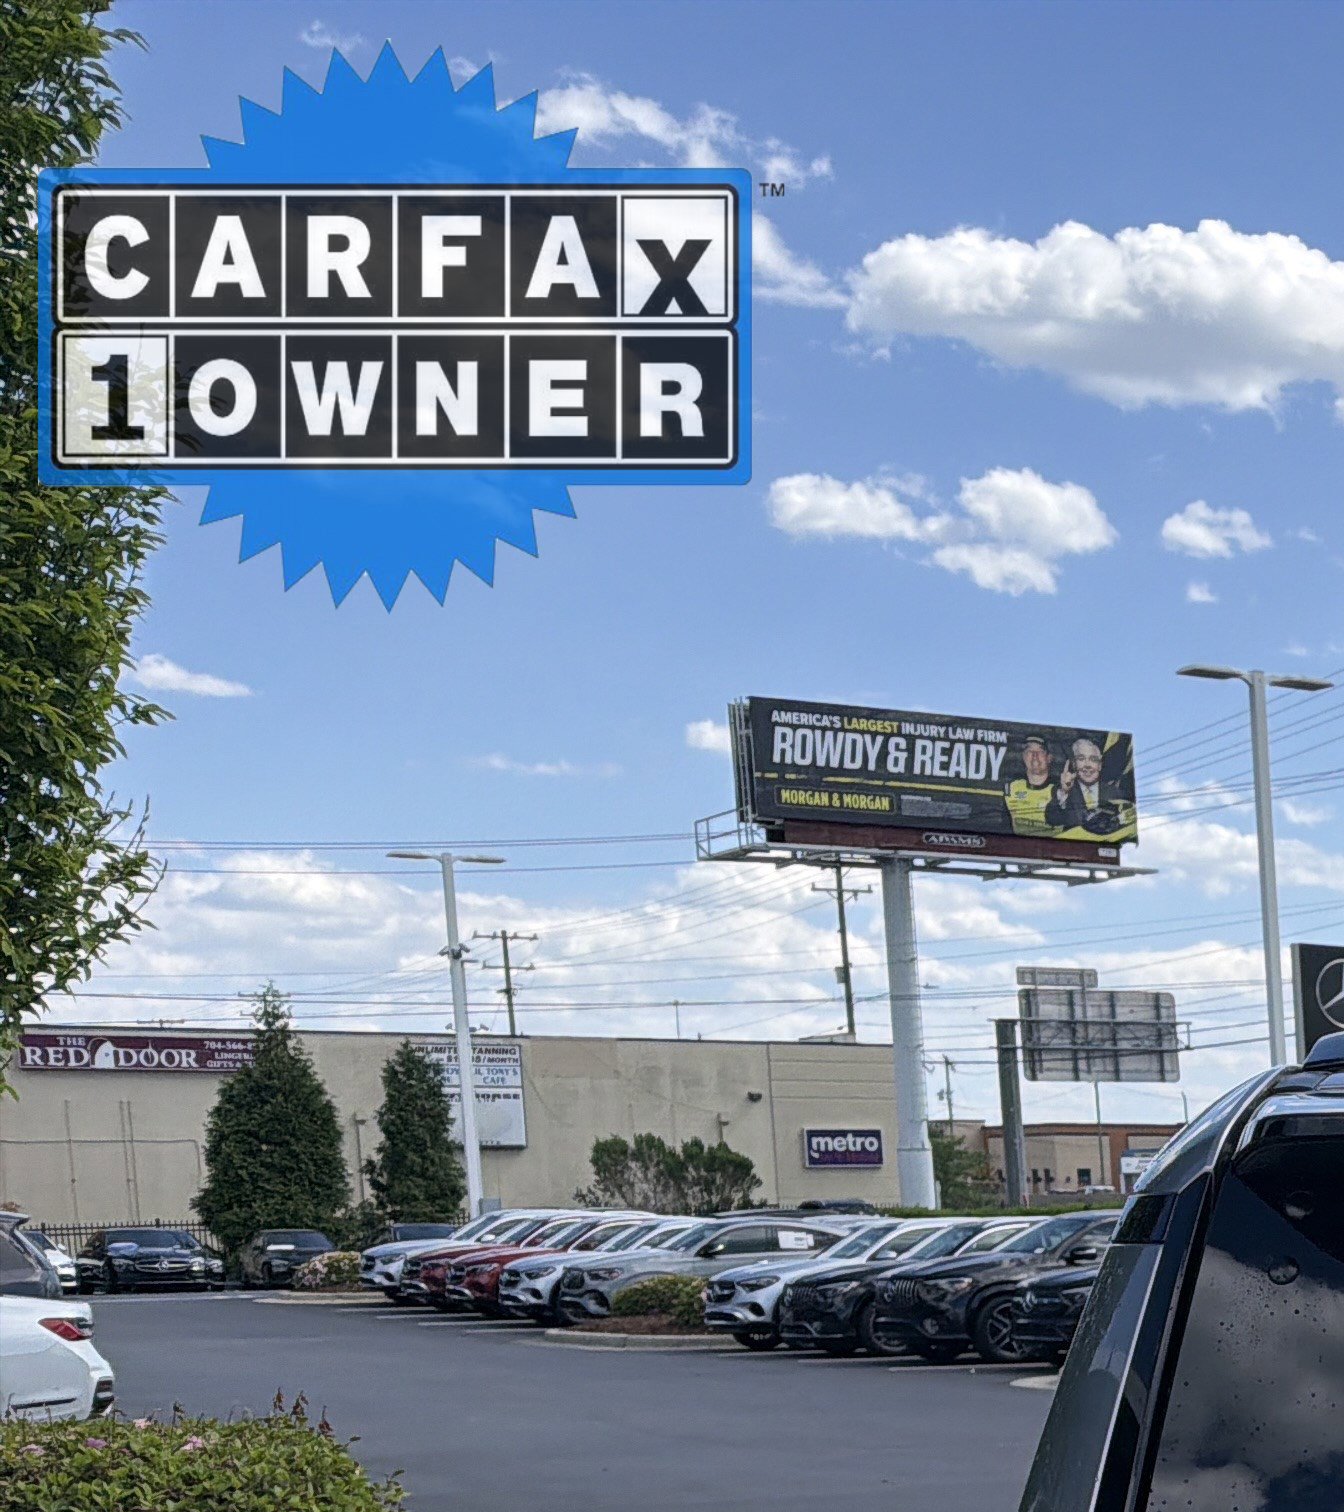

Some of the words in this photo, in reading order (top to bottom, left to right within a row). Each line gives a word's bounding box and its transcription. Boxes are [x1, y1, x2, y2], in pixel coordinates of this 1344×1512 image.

[771, 709, 842, 729] AMERICA'S
[843, 716, 899, 734] LARGEST
[901, 721, 947, 738] INJURY
[948, 727, 975, 741] LAW
[976, 729, 1008, 744] FIRM
[772, 725, 885, 772] ROWDY
[886, 736, 908, 774] &
[913, 738, 1008, 782] READY
[780, 789, 829, 806] MORGAN
[831, 791, 841, 808] &
[842, 793, 890, 812] MORGAN
[57, 1036, 86, 1046] THE
[24, 1047, 91, 1067] RED
[118, 1047, 200, 1068] DOOR
[811, 1133, 879, 1152] metro
